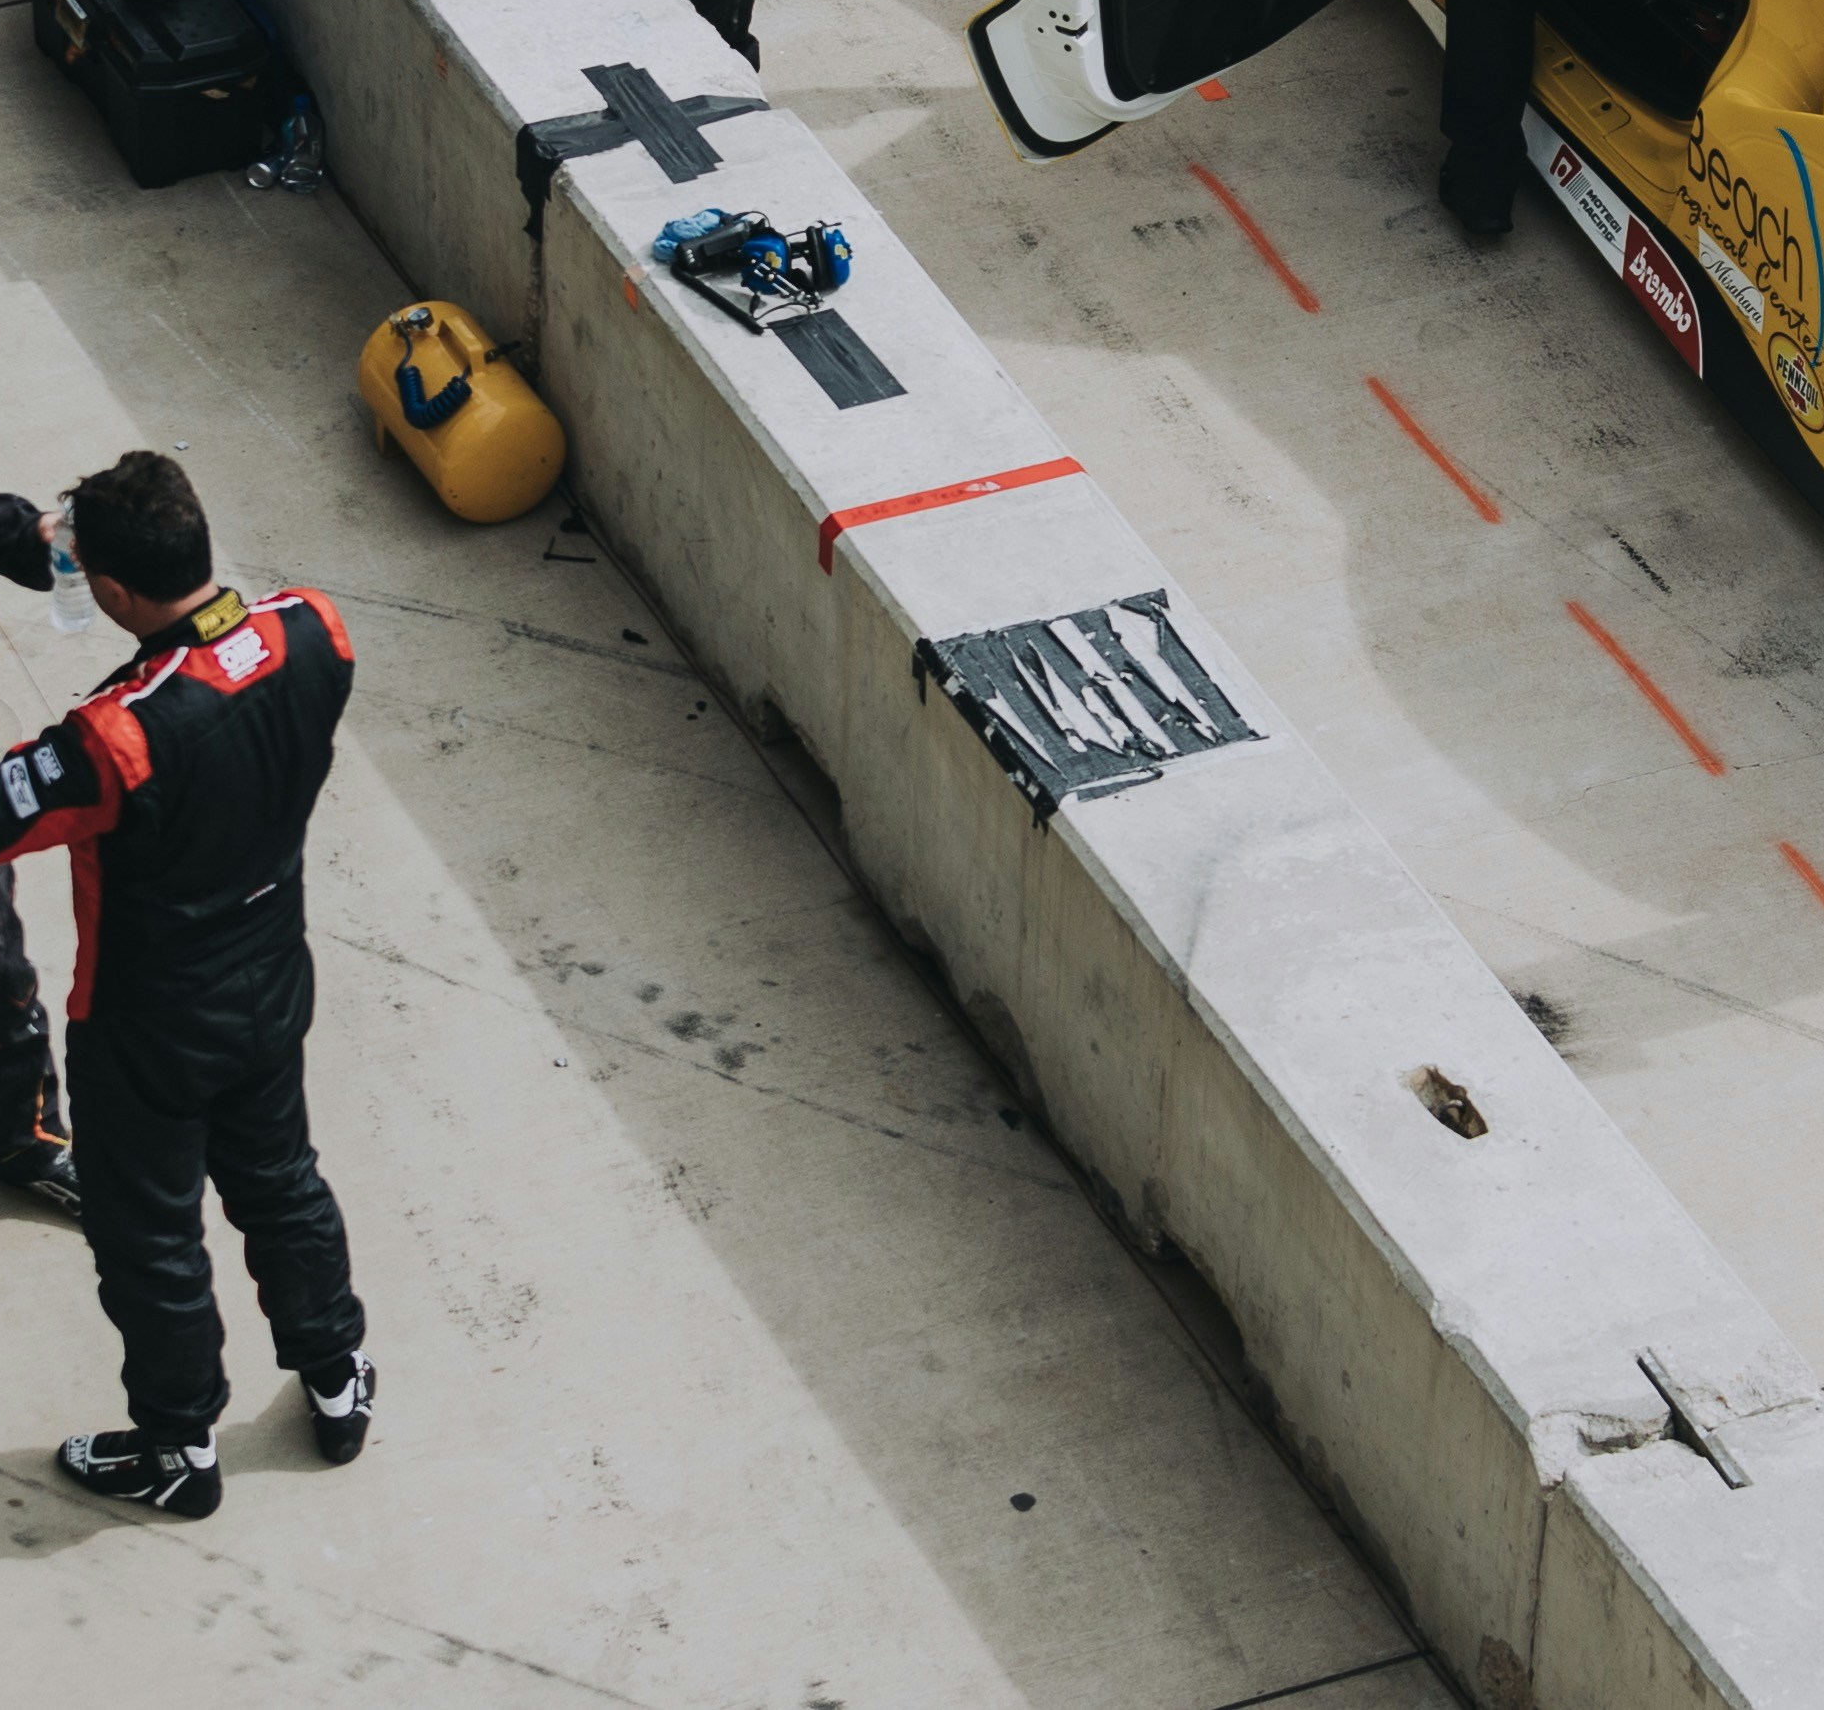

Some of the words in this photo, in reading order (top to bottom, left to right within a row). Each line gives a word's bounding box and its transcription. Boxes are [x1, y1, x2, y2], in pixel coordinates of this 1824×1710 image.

[1578, 197, 1617, 244] RACING
[1585, 188, 1623, 235] MOTEGI
[1686, 106, 1803, 302] Beach
[1628, 246, 1692, 333] brembo
[1775, 352, 1821, 412] PENNZOIL
